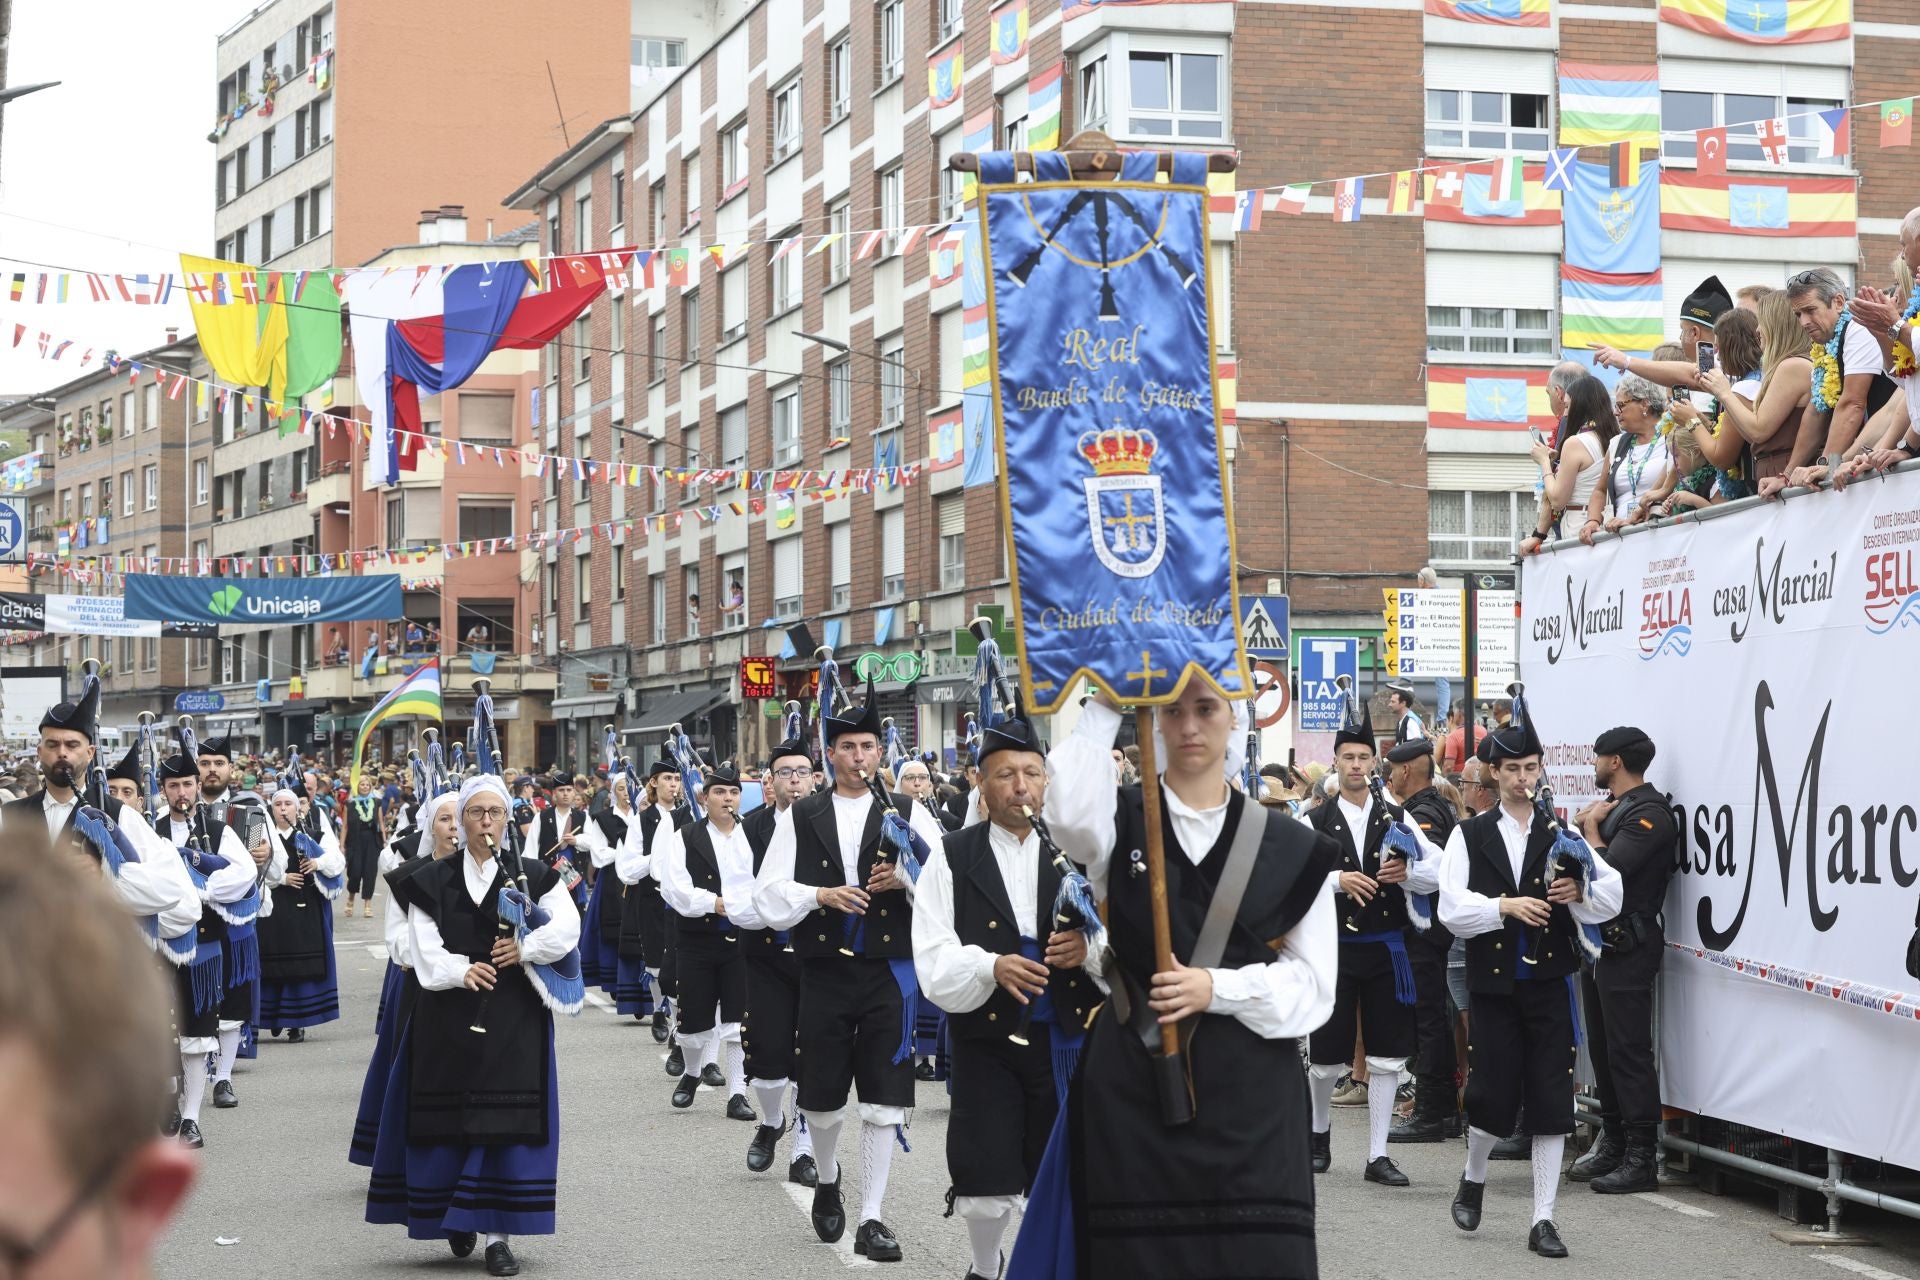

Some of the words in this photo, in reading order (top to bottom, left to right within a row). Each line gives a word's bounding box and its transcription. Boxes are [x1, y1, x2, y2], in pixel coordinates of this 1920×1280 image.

[1064, 324, 1144, 371] Real
[1017, 377, 1089, 411] Banda
[1102, 376, 1127, 403] de
[1140, 381, 1202, 412] Gaitas
[246, 595, 320, 618] Unicaja
[1714, 585, 1747, 617] casa
[1730, 536, 1838, 643] Marcial
[1039, 597, 1119, 631] Ciudad
[1131, 596, 1153, 623] de
[1533, 615, 1561, 642] casa
[1547, 574, 1624, 665] Marcial
[1641, 587, 1692, 632] SELLA
[1312, 641, 1346, 679] T
[1302, 702, 1319, 711] 985
[1320, 702, 1337, 711] 840
[1302, 711, 1336, 719] SERVICIO
[1666, 793, 1737, 878] asa
